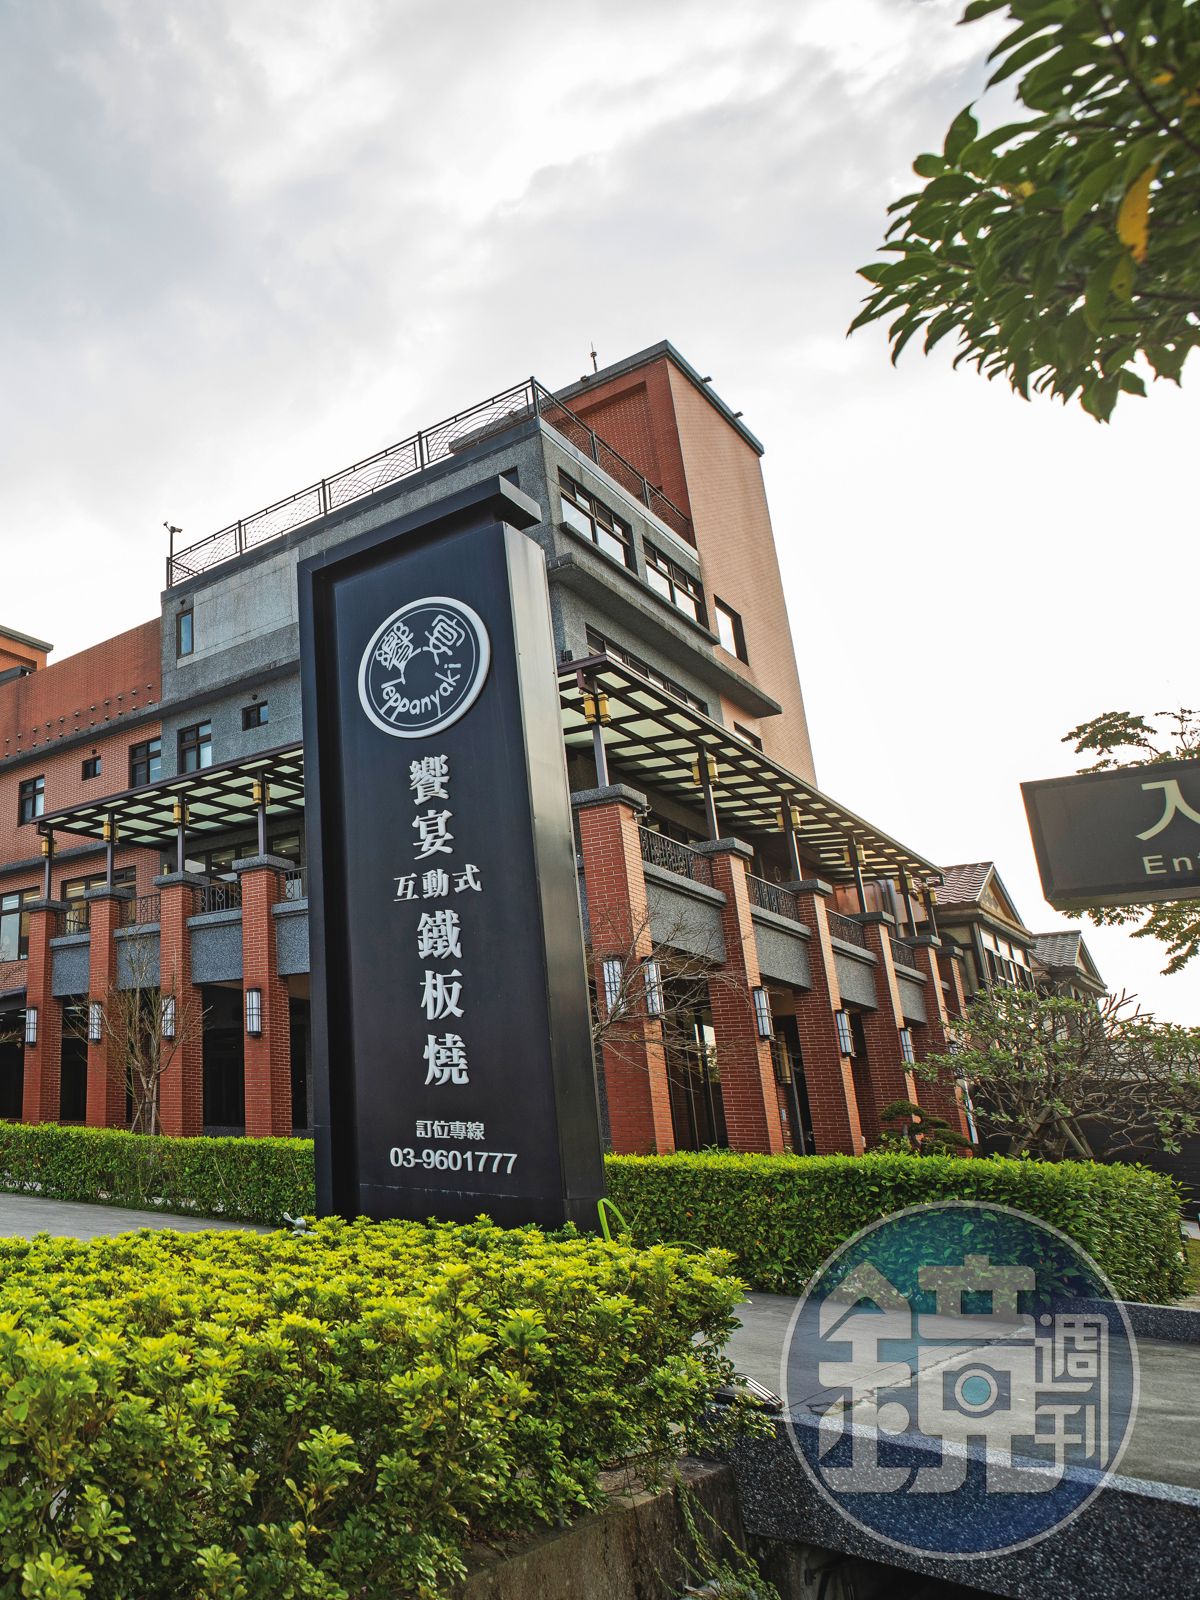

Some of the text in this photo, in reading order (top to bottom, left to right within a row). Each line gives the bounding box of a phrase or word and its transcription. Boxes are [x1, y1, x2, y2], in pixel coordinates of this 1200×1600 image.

[408, 754, 455, 860] 饗宴
[1135, 779, 1200, 841] 入
[1142, 852, 1200, 875] En
[393, 864, 483, 902] 互動式
[416, 909, 470, 1086] 鐵板燒
[415, 1119, 486, 1141] 訂位專線
[389, 1147, 518, 1174] 03-9601777
